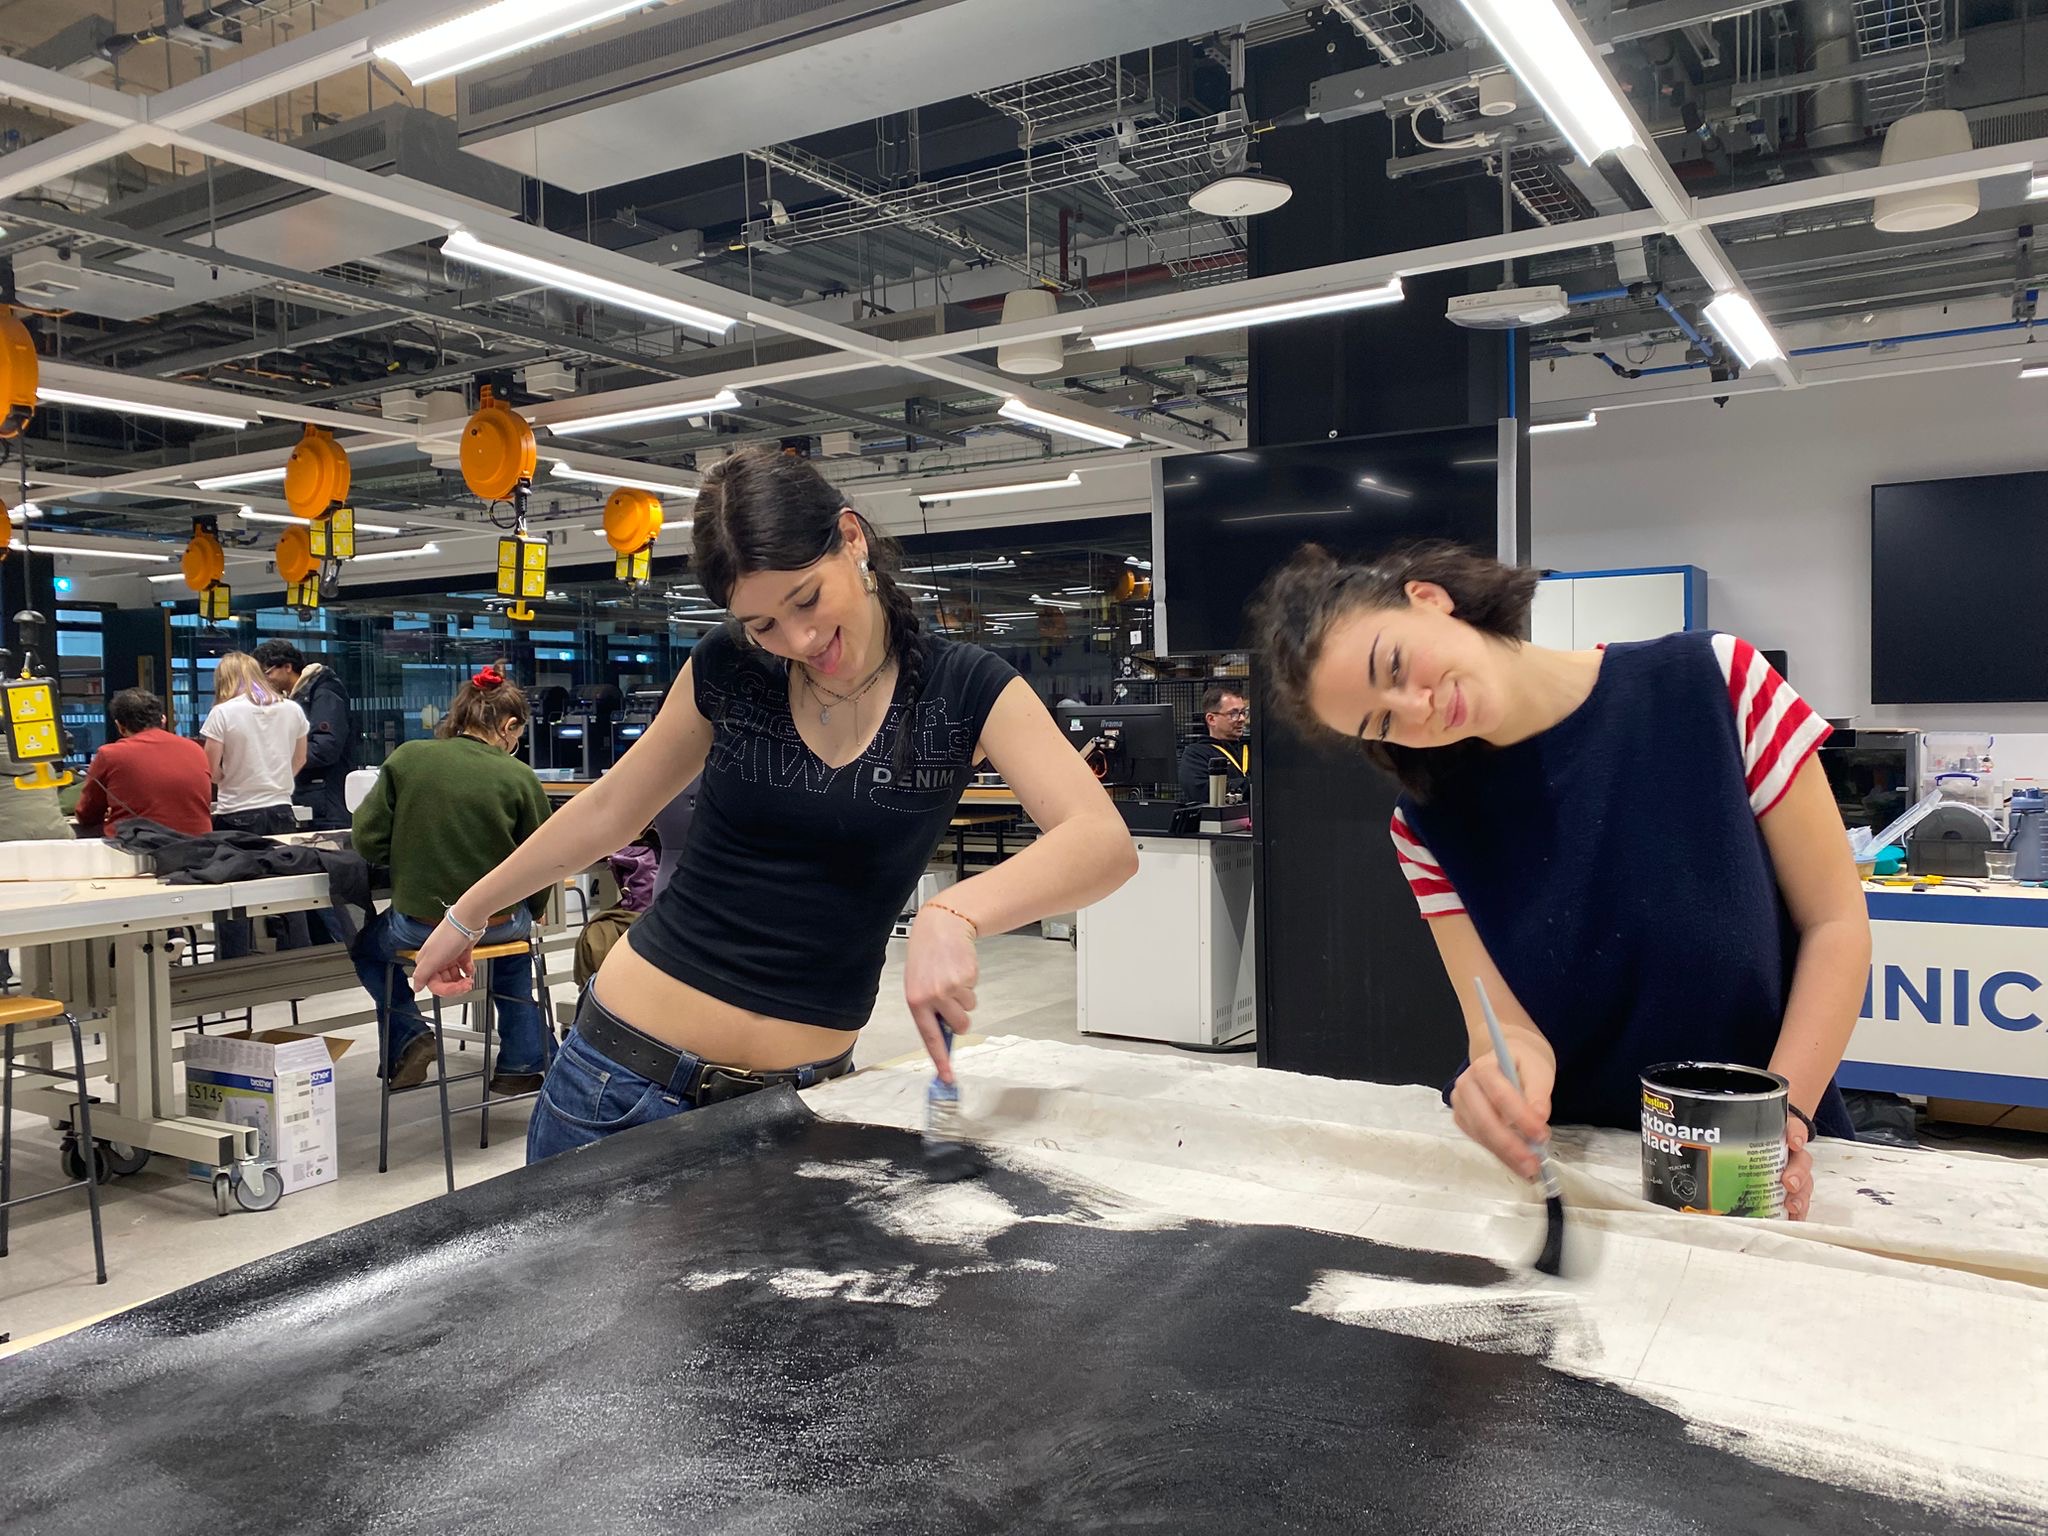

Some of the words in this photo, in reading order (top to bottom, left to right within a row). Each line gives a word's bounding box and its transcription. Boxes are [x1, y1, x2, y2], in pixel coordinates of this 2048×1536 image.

[1859, 964, 2048, 1032] NIC
[188, 1083, 223, 1103] LS14s
[1641, 1111, 1721, 1143] ckboard
[1642, 1127, 1683, 1157] Black
